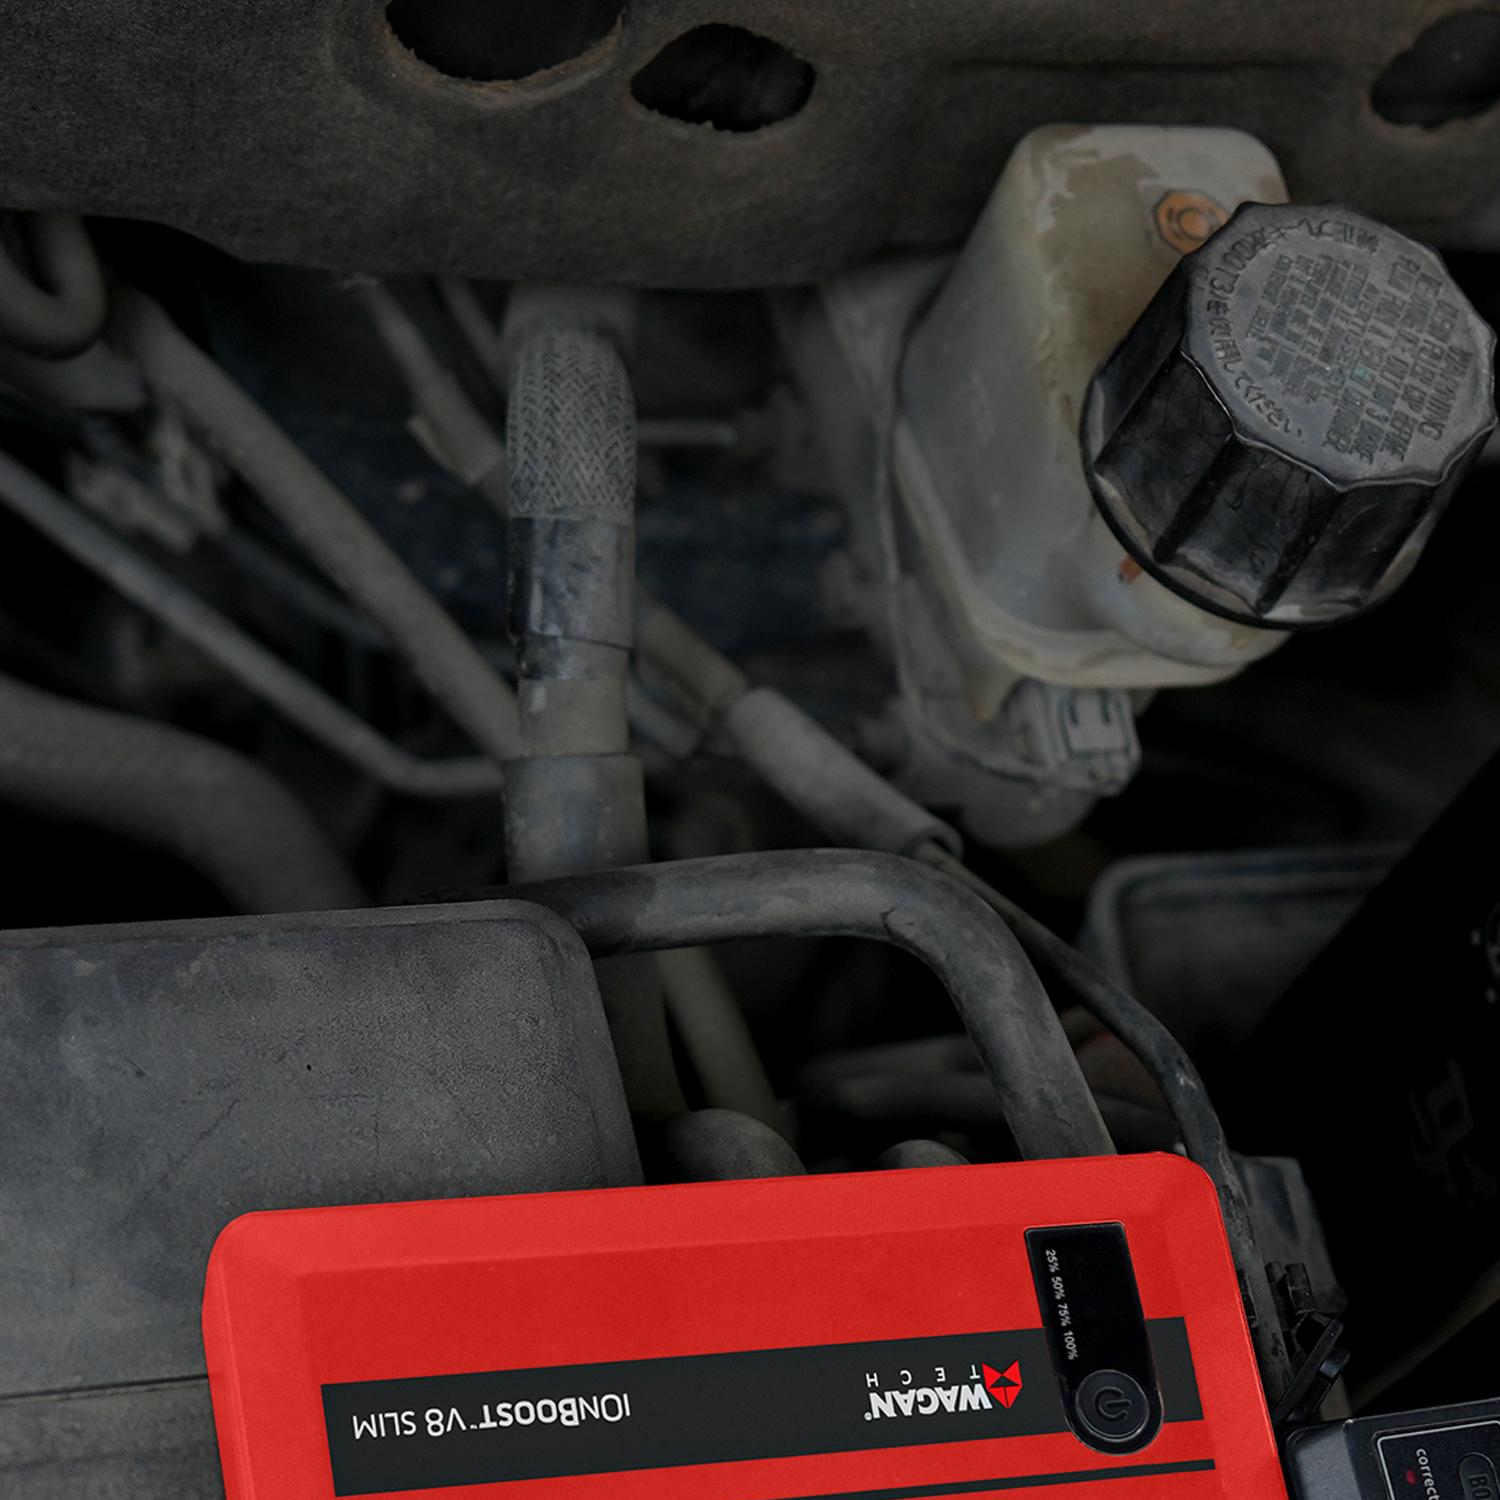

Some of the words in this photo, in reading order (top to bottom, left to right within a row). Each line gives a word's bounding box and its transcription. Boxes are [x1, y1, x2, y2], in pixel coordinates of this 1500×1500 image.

[1416, 345, 1474, 441] WARNING
[1045, 1249, 1060, 1273] 25%
[1051, 1276, 1067, 1301] 50%
[1057, 1303, 1072, 1328] 75%
[1063, 1330, 1079, 1361] 100%
[351, 1409, 416, 1439] SLIM
[423, 1405, 466, 1437] V8
